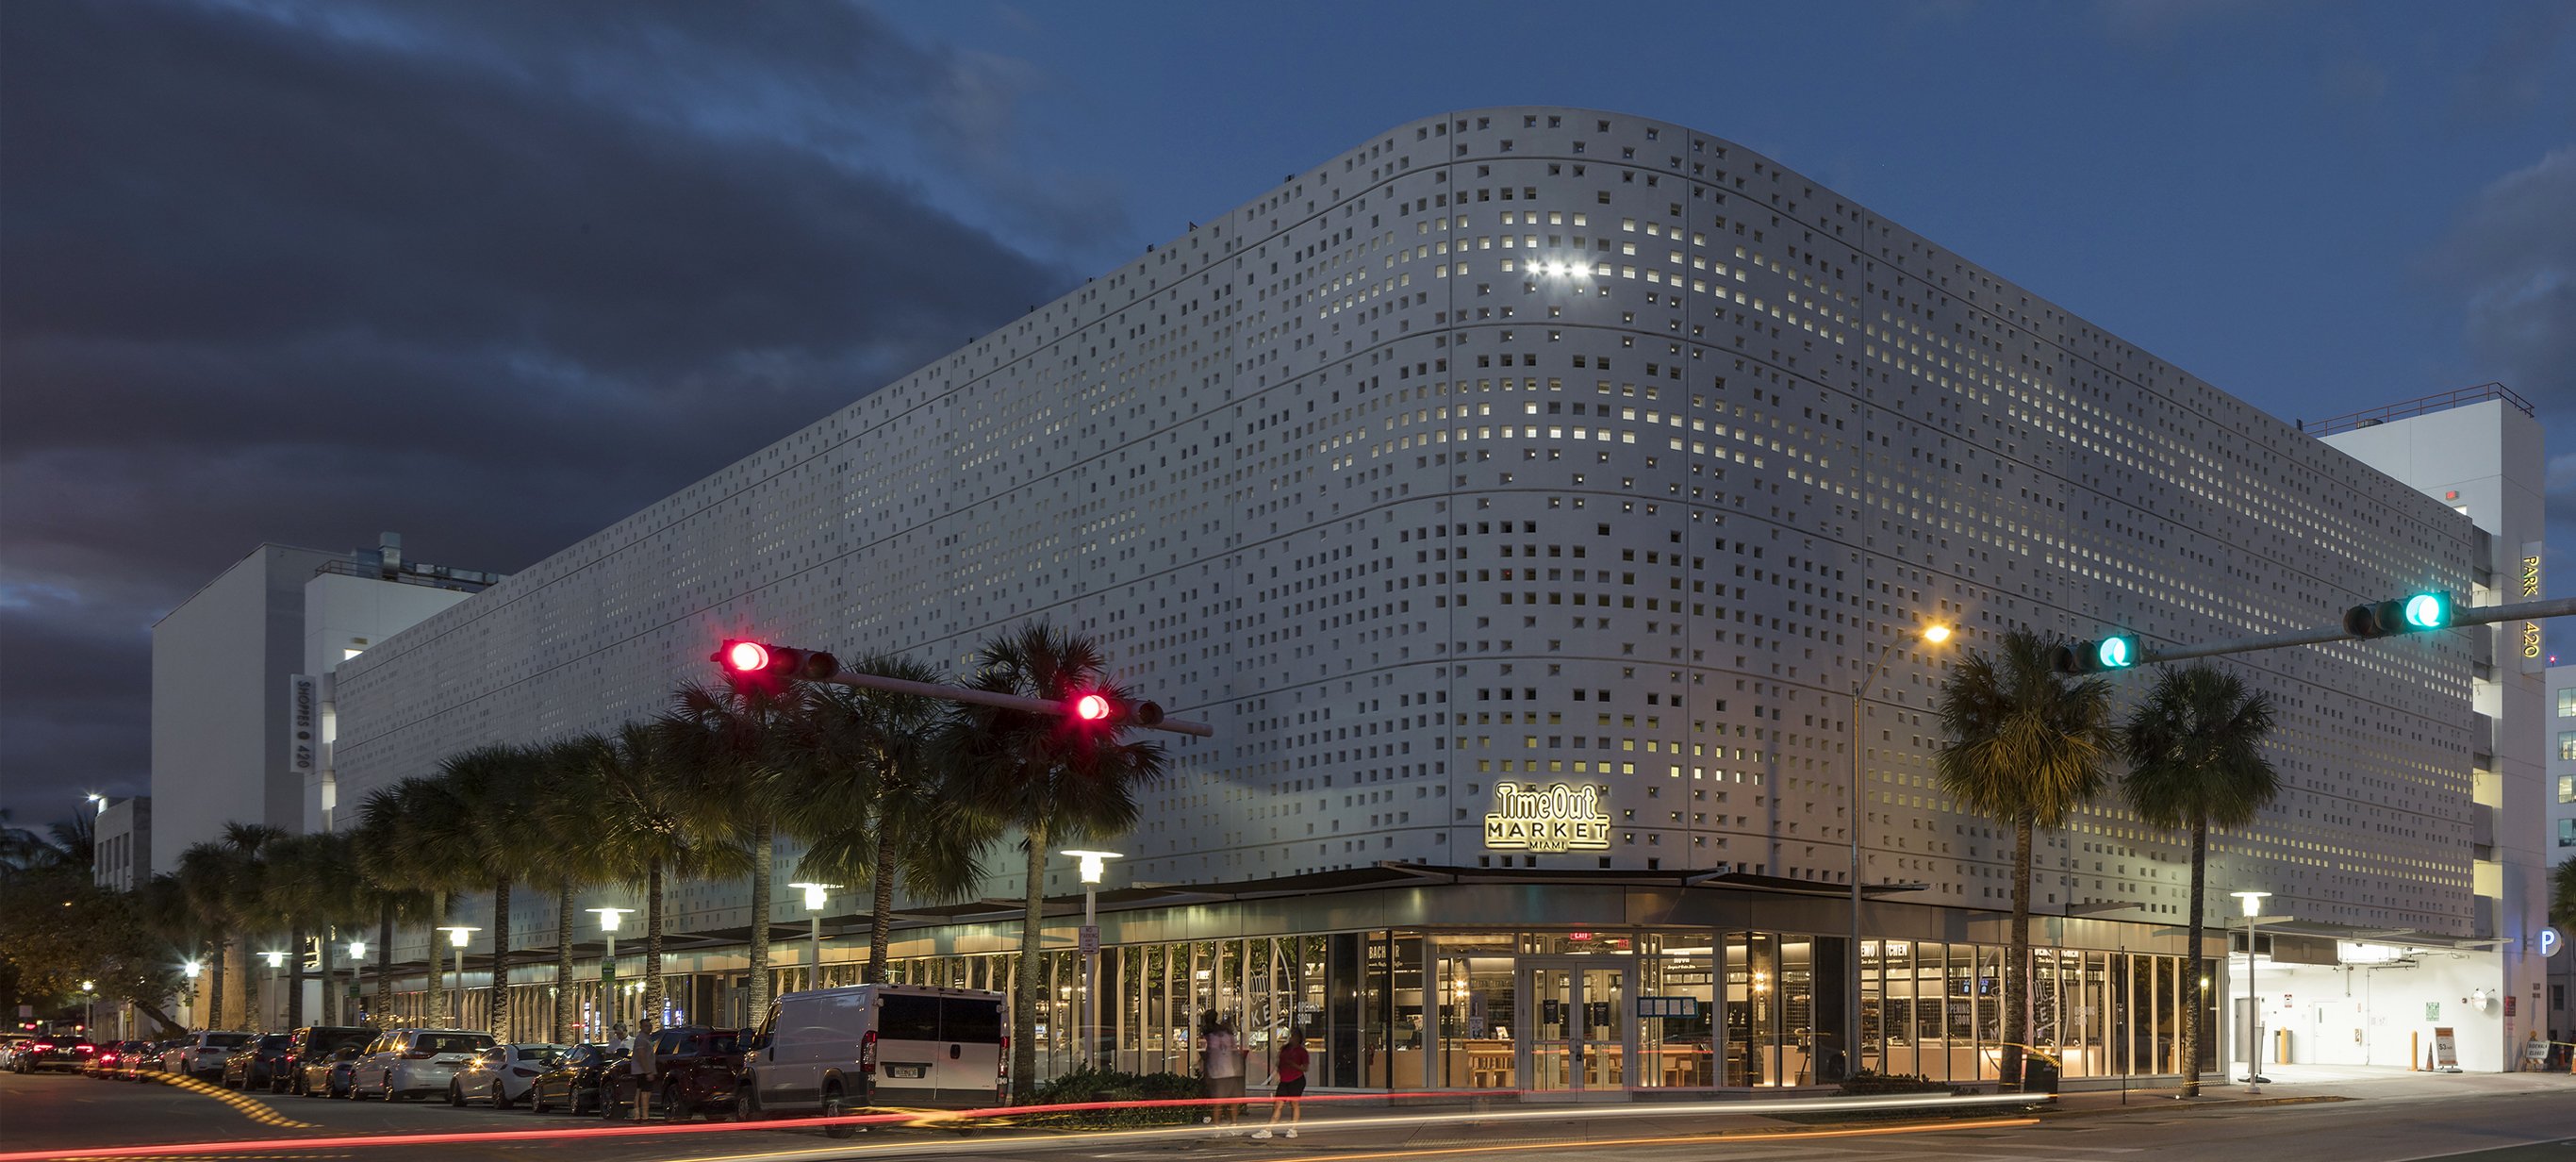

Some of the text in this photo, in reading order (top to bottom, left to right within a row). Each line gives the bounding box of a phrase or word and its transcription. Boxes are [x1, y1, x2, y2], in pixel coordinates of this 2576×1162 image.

[2523, 556, 2540, 657] PARK 420
[297, 681, 311, 727] SHOPPES
[297, 745, 311, 768] 420
[1488, 822, 1608, 838] MARKET
[1369, 944, 1400, 959] BACHR
[2540, 930, 2555, 954] P
